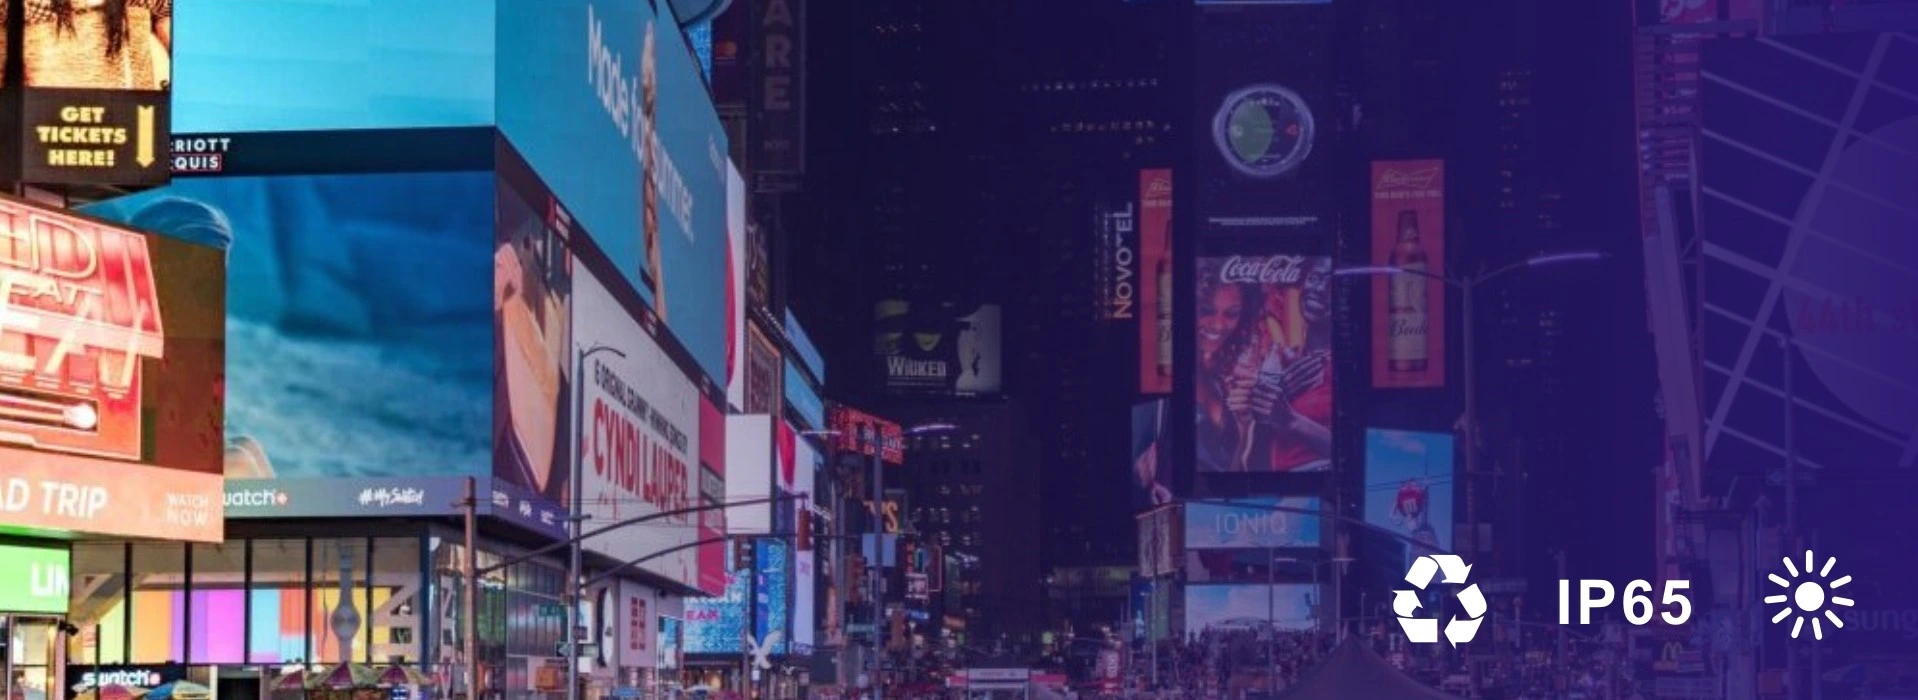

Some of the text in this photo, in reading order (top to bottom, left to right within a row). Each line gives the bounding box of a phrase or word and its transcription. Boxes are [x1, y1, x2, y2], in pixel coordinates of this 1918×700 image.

[588, 3, 629, 139] Made
[60, 106, 105, 123] GET
[36, 126, 127, 144] TICKETS
[171, 138, 231, 153] RIOTT
[48, 149, 115, 167] HERE!
[171, 155, 219, 171] QUIS
[1112, 201, 1133, 319] NOVOTEL
[594, 397, 639, 497] CYNDI
[642, 432, 688, 528] LAUPER
[40, 481, 107, 519] TRIP
[166, 492, 209, 506] WATCH
[166, 507, 208, 527] NOW
[1216, 512, 1288, 535] IONIQ
